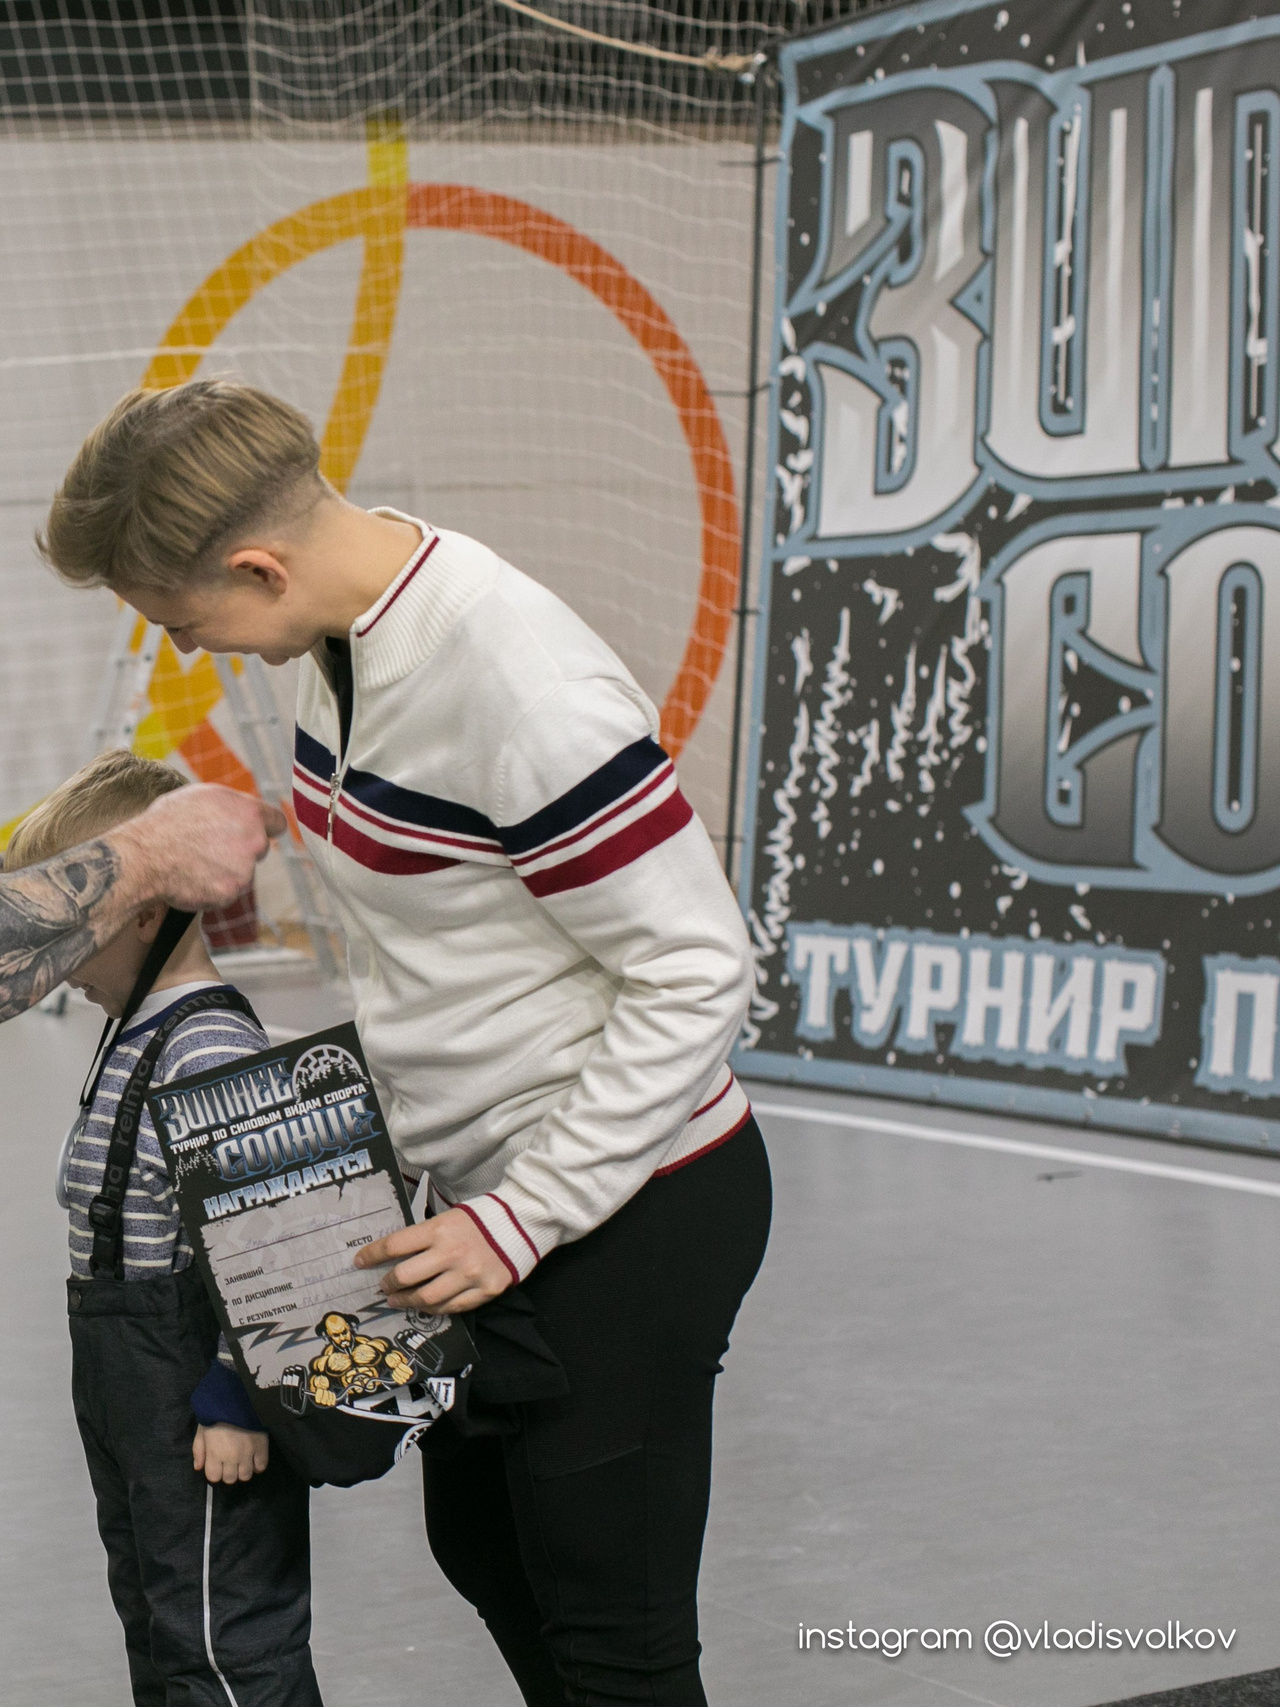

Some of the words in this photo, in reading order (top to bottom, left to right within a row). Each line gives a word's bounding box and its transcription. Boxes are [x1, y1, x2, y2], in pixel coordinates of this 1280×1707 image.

[156, 991, 230, 1042] reima
[791, 927, 1161, 1068] ТУРНИР
[115, 1058, 152, 1147] reima
[155, 1059, 294, 1144] ЗИМНЕЕ
[170, 1135, 210, 1155] ТУРНИР
[212, 1128, 228, 1142] ПО
[229, 1110, 282, 1136] СИЛОВЫМ
[285, 1098, 322, 1117] ВИДАМ
[323, 1083, 367, 1105] СПОРТА
[214, 1096, 378, 1181] СОЛНЦЕ
[203, 1148, 374, 1220] НАГРАЖДАЕТСЯ
[224, 1267, 264, 1286] ЗАНЯВШИЙ
[345, 1235, 373, 1249] МЕСТО
[232, 1296, 243, 1306] ПО
[244, 1282, 294, 1304] ДИСЦИПЛИНЕ
[239, 1317, 245, 1325] С
[246, 1302, 298, 1324] РЕЗУЛЬТАТОМ
